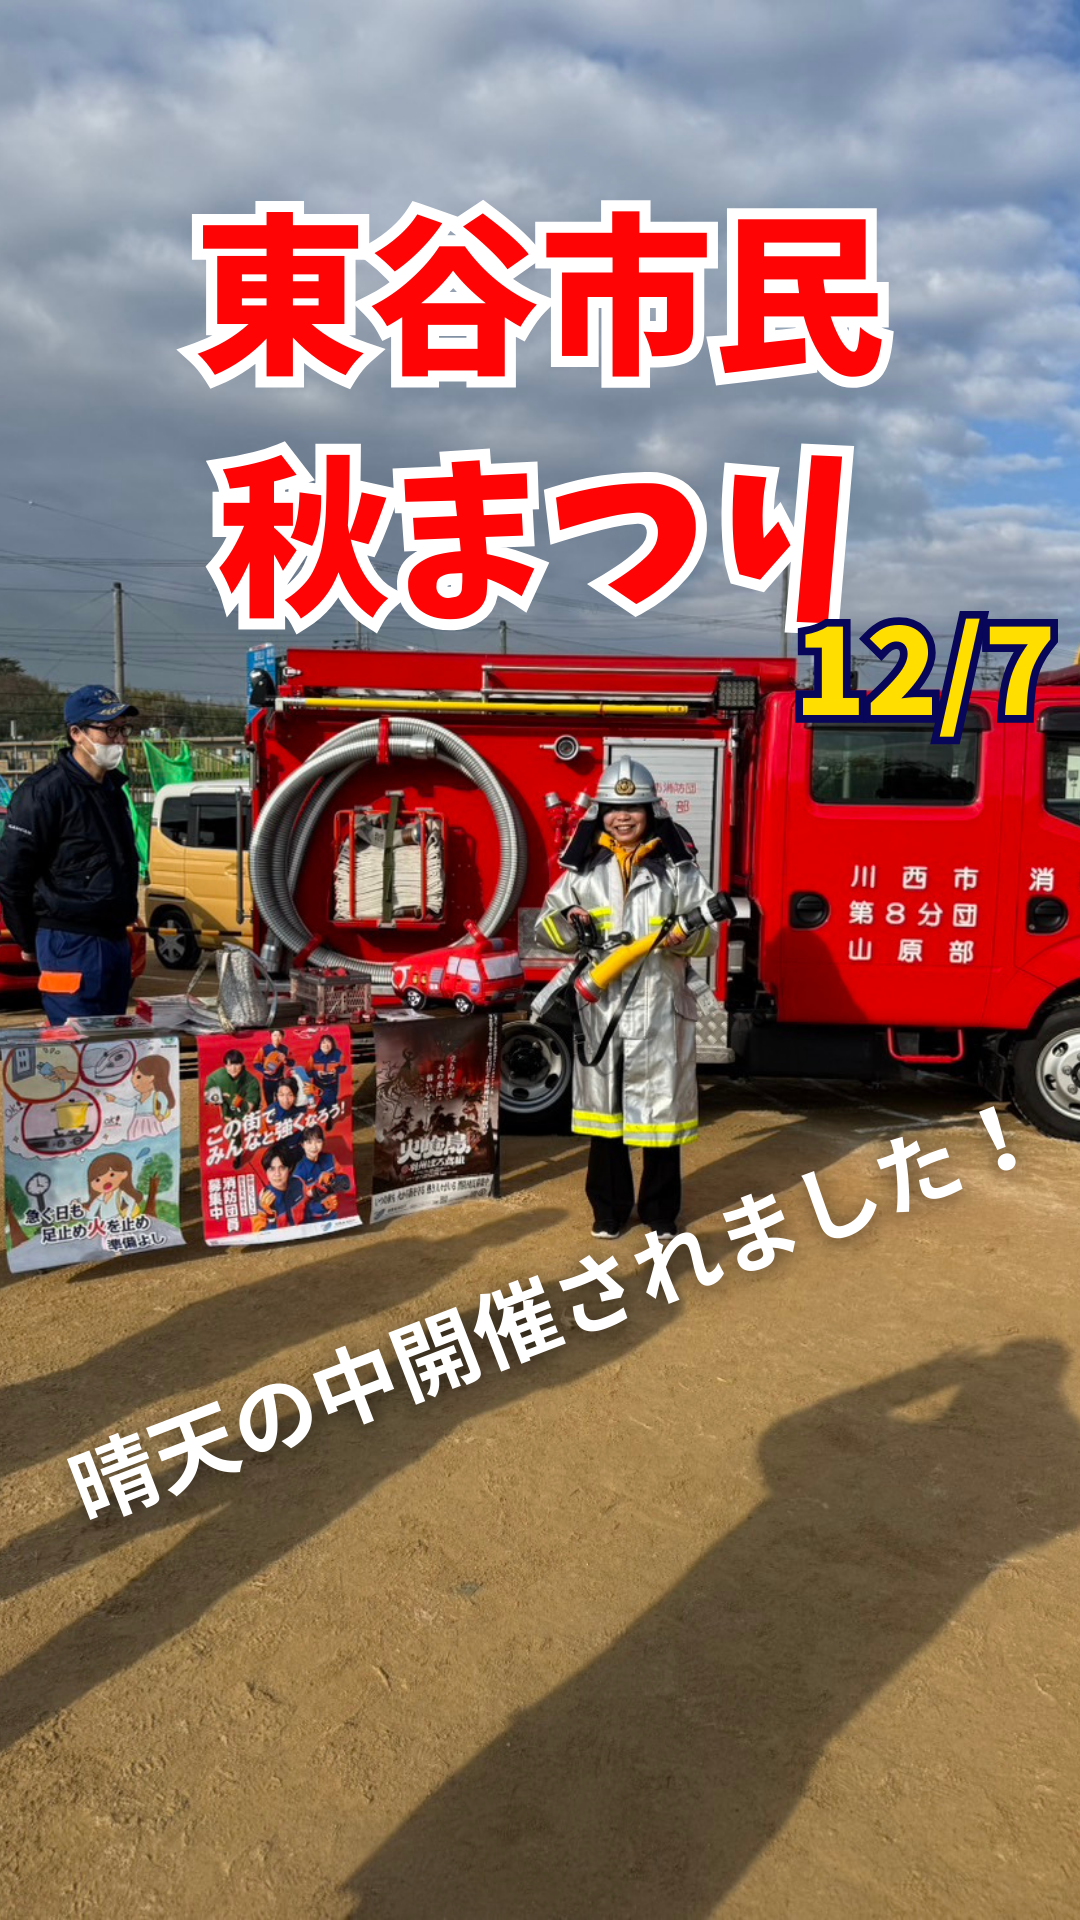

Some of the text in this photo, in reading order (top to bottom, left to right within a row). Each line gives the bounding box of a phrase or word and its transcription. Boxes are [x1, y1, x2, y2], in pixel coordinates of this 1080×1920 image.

[851, 865, 1055, 892] 川西市 消
[849, 901, 978, 929] 第8分団
[849, 938, 974, 964] 山原部
[206, 1107, 277, 1147] この街で
[208, 1178, 223, 1219] 募集中
[223, 1177, 239, 1233] 消防団員
[25, 1204, 85, 1224] 急ぐ日も
[42, 1216, 150, 1243] 足止め火を止め
[107, 1233, 167, 1251] 準備よし
